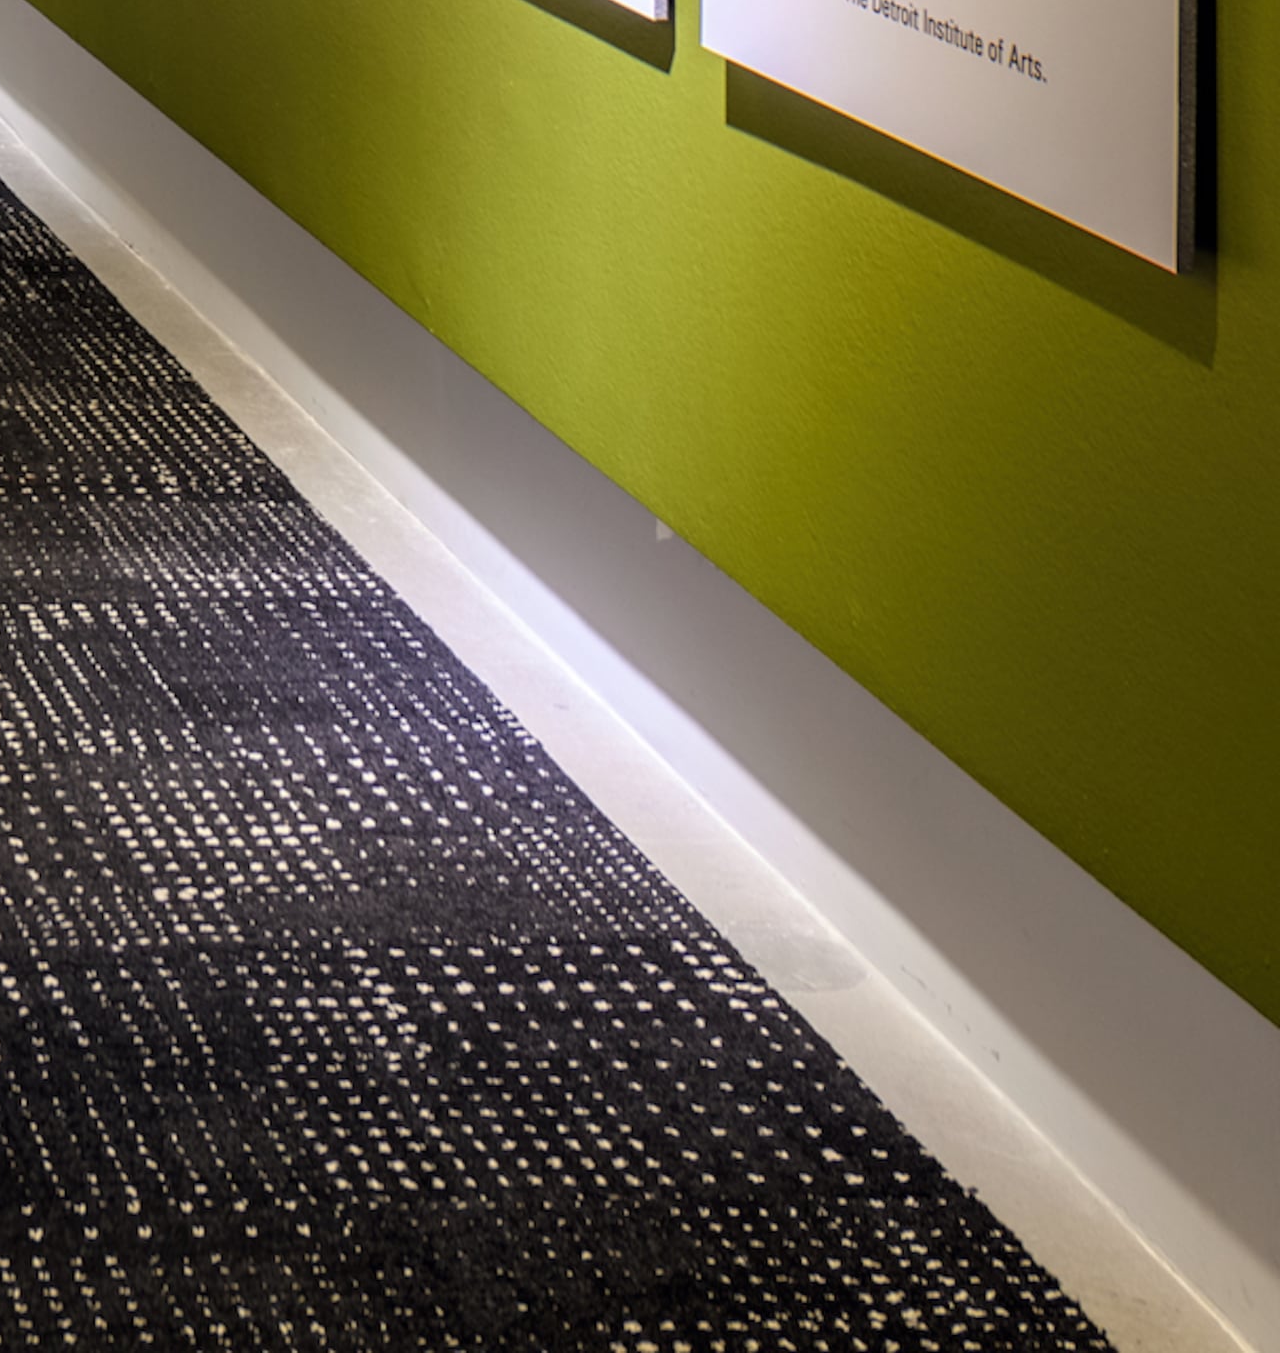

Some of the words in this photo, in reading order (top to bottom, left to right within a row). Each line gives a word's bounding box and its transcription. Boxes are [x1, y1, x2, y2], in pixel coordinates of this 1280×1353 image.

[923, 8, 984, 58] Institute
[987, 38, 1004, 66] of
[1008, 44, 1047, 84] Arts.
